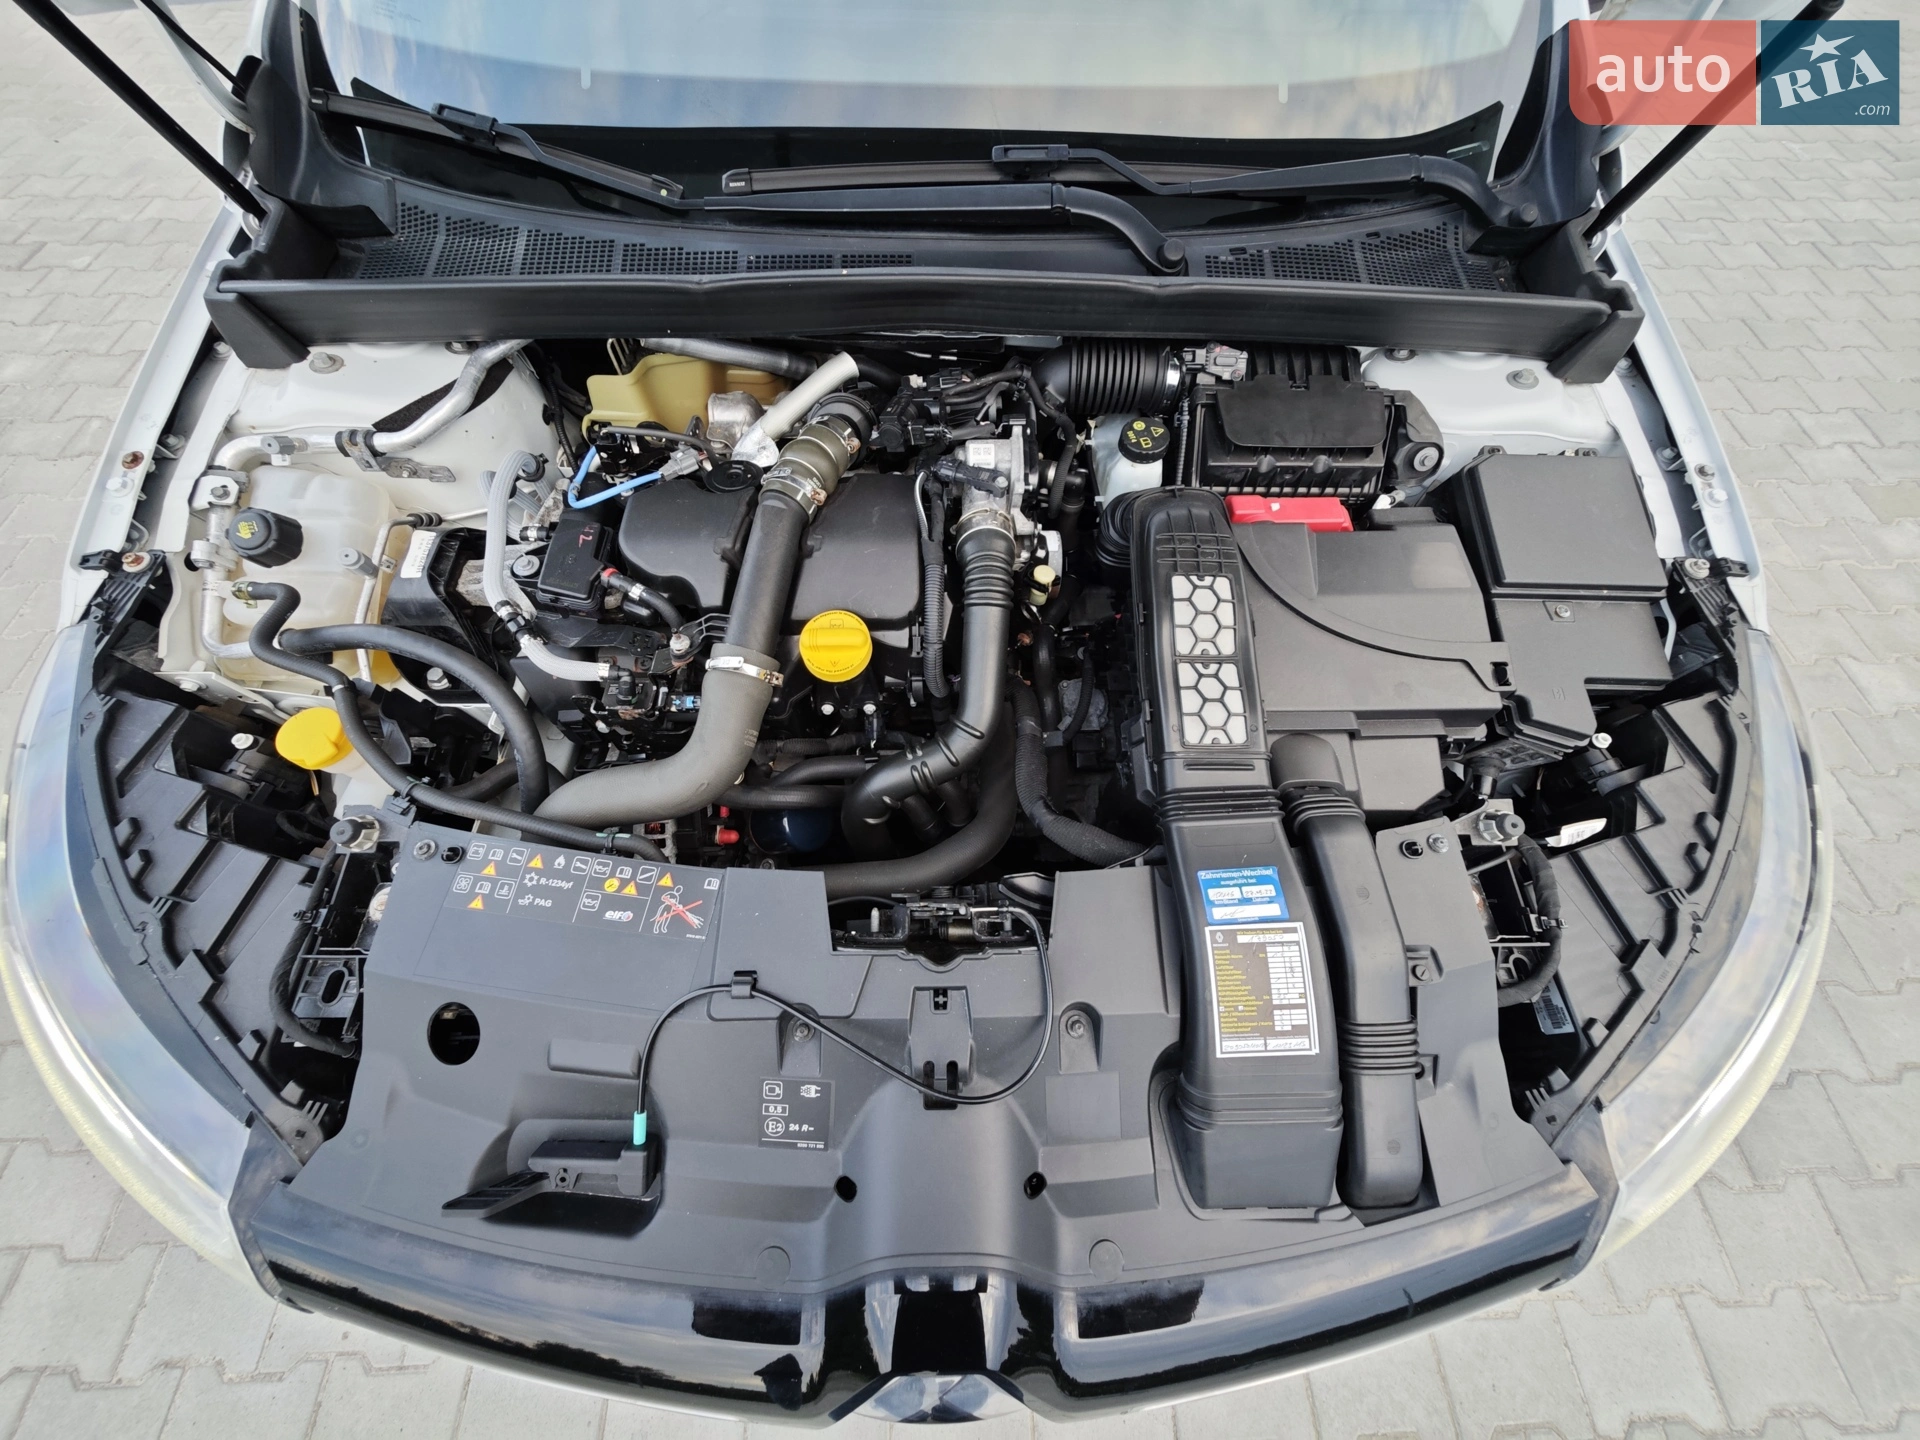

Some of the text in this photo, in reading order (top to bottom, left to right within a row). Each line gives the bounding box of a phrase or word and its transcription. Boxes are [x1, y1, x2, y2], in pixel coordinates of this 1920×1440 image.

[1200, 868, 1273, 879] Zahnriemen-Wechsel
[539, 877, 574, 890] R-1234yf
[533, 897, 553, 908] PAG
[768, 1105, 782, 1114] 0,5
[768, 1121, 783, 1133] E2
[788, 1123, 800, 1131] 24
